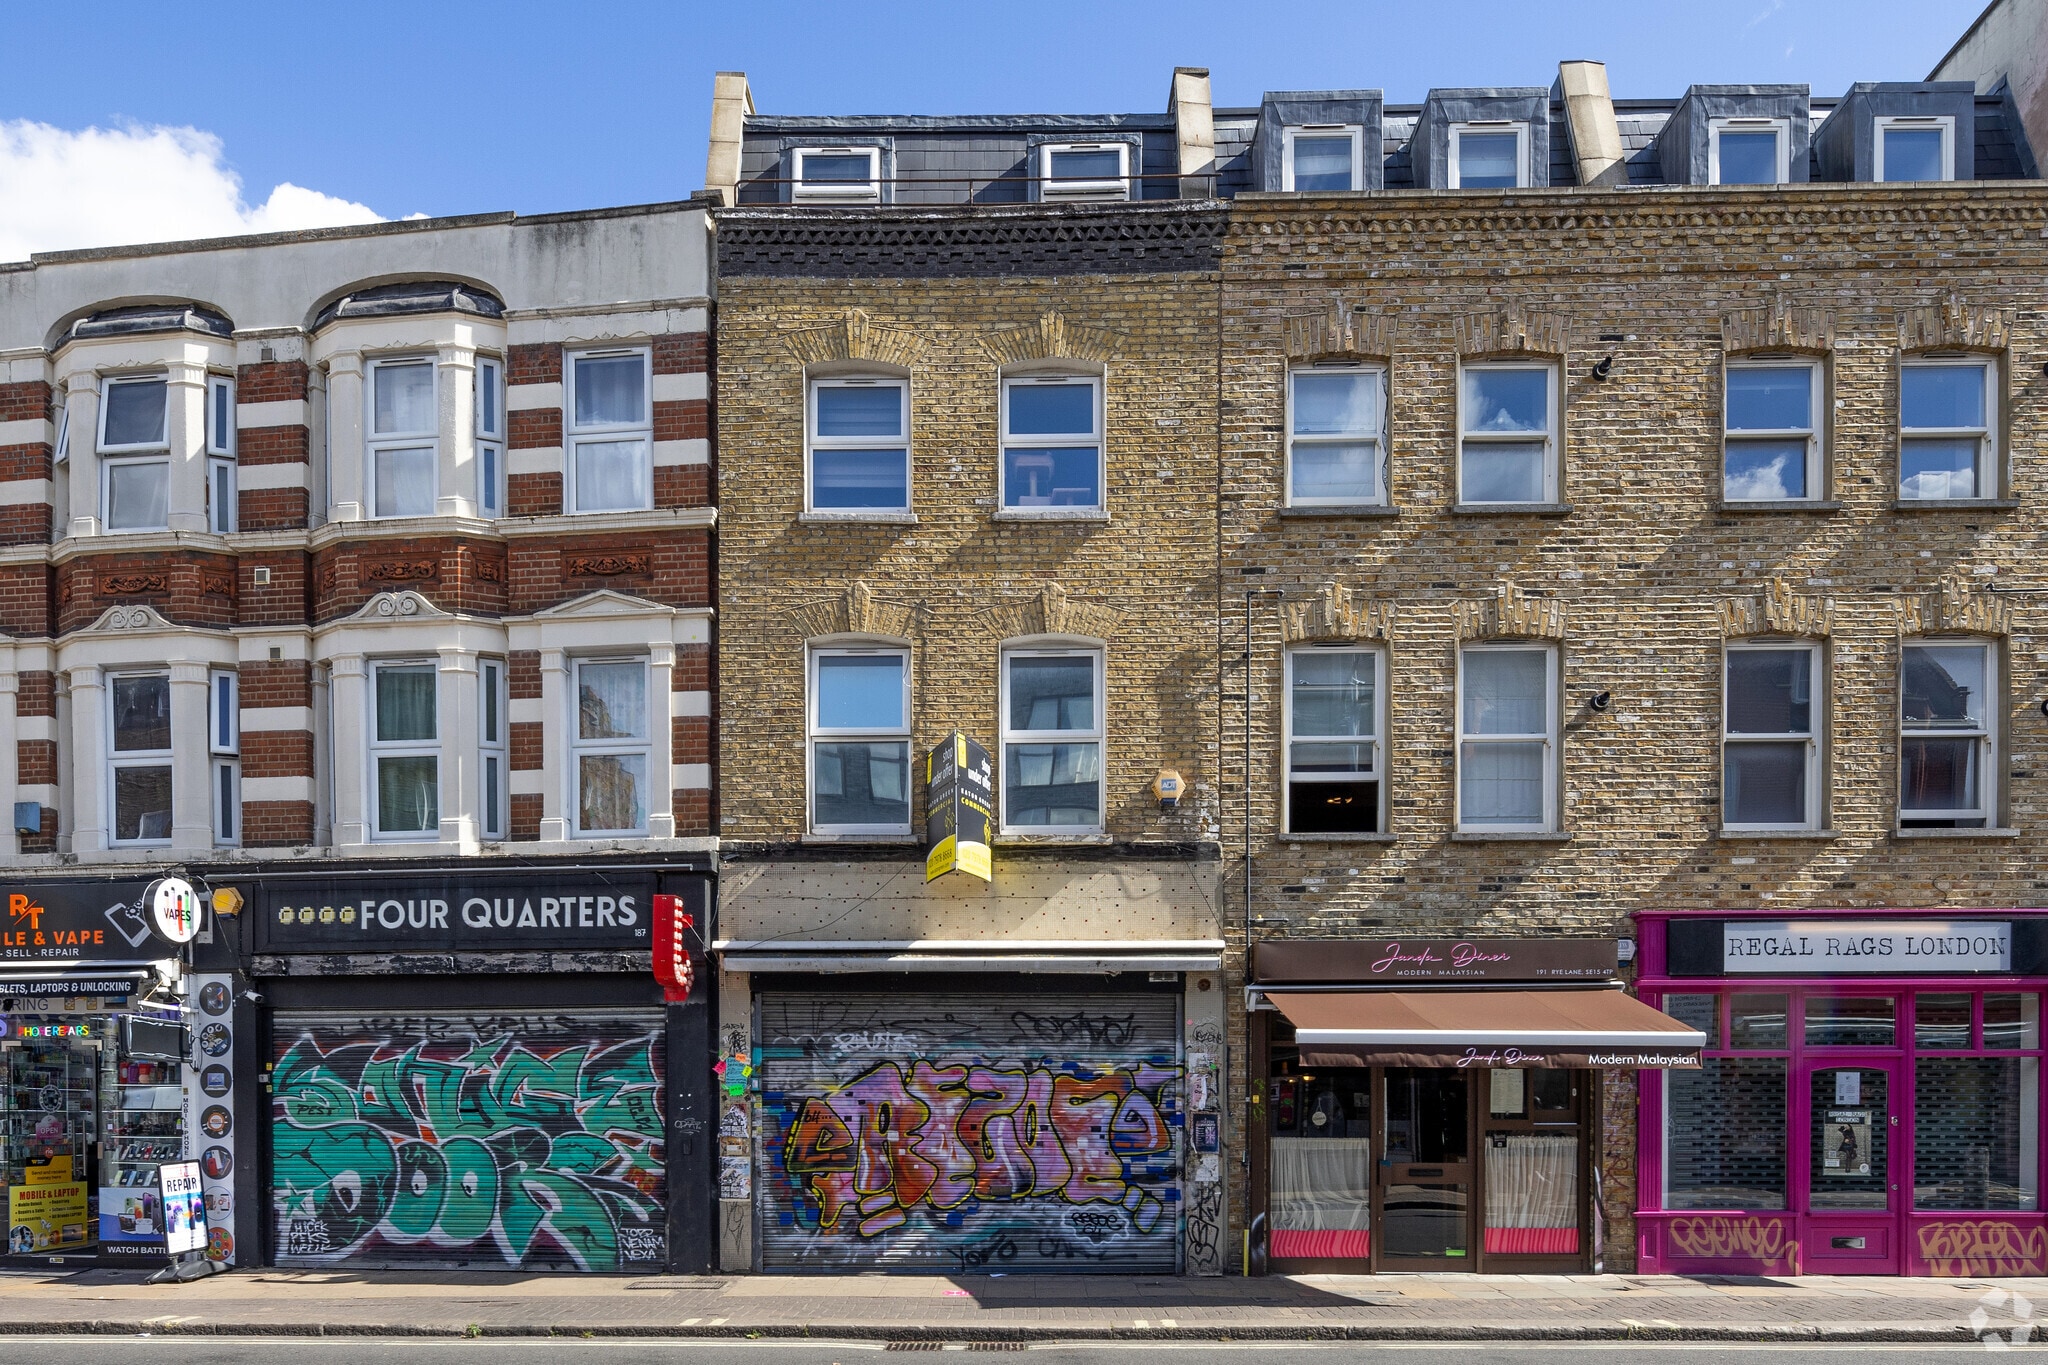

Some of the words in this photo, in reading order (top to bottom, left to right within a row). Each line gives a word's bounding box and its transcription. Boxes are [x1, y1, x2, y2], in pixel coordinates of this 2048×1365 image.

[943, 746, 954, 763] shop
[931, 771, 943, 788] under
[943, 762, 954, 779] offer
[961, 787, 978, 800] EATON
[961, 797, 991, 819] COMMERCIAL
[164, 907, 192, 922] VAPES
[361, 899, 449, 930] FOUR
[461, 895, 637, 929] QUARTERS
[34, 930, 46, 945] &
[53, 929, 105, 945] VAPE
[634, 928, 647, 937] 187
[6, 949, 32, 957] SELL
[41, 948, 80, 957] REPAIR
[1728, 936, 1815, 957] REGAL
[1825, 936, 1894, 957] RAGS
[1904, 936, 2007, 957] LONDON
[1450, 942, 1511, 968] Diner
[30, 982, 70, 993] LAPTOPS
[71, 982, 79, 992] &
[80, 981, 132, 993] UNLOCKING
[1588, 1053, 1635, 1065] Modern
[1637, 1052, 1698, 1067] Malaysian
[40, 1126, 59, 1134] OPEN
[166, 1177, 198, 1193] REPAIR
[19, 1190, 46, 1201] MOBILE
[47, 1190, 53, 1199] &
[54, 1187, 80, 1198] LAPTOP
[107, 1246, 139, 1254] WATCH
